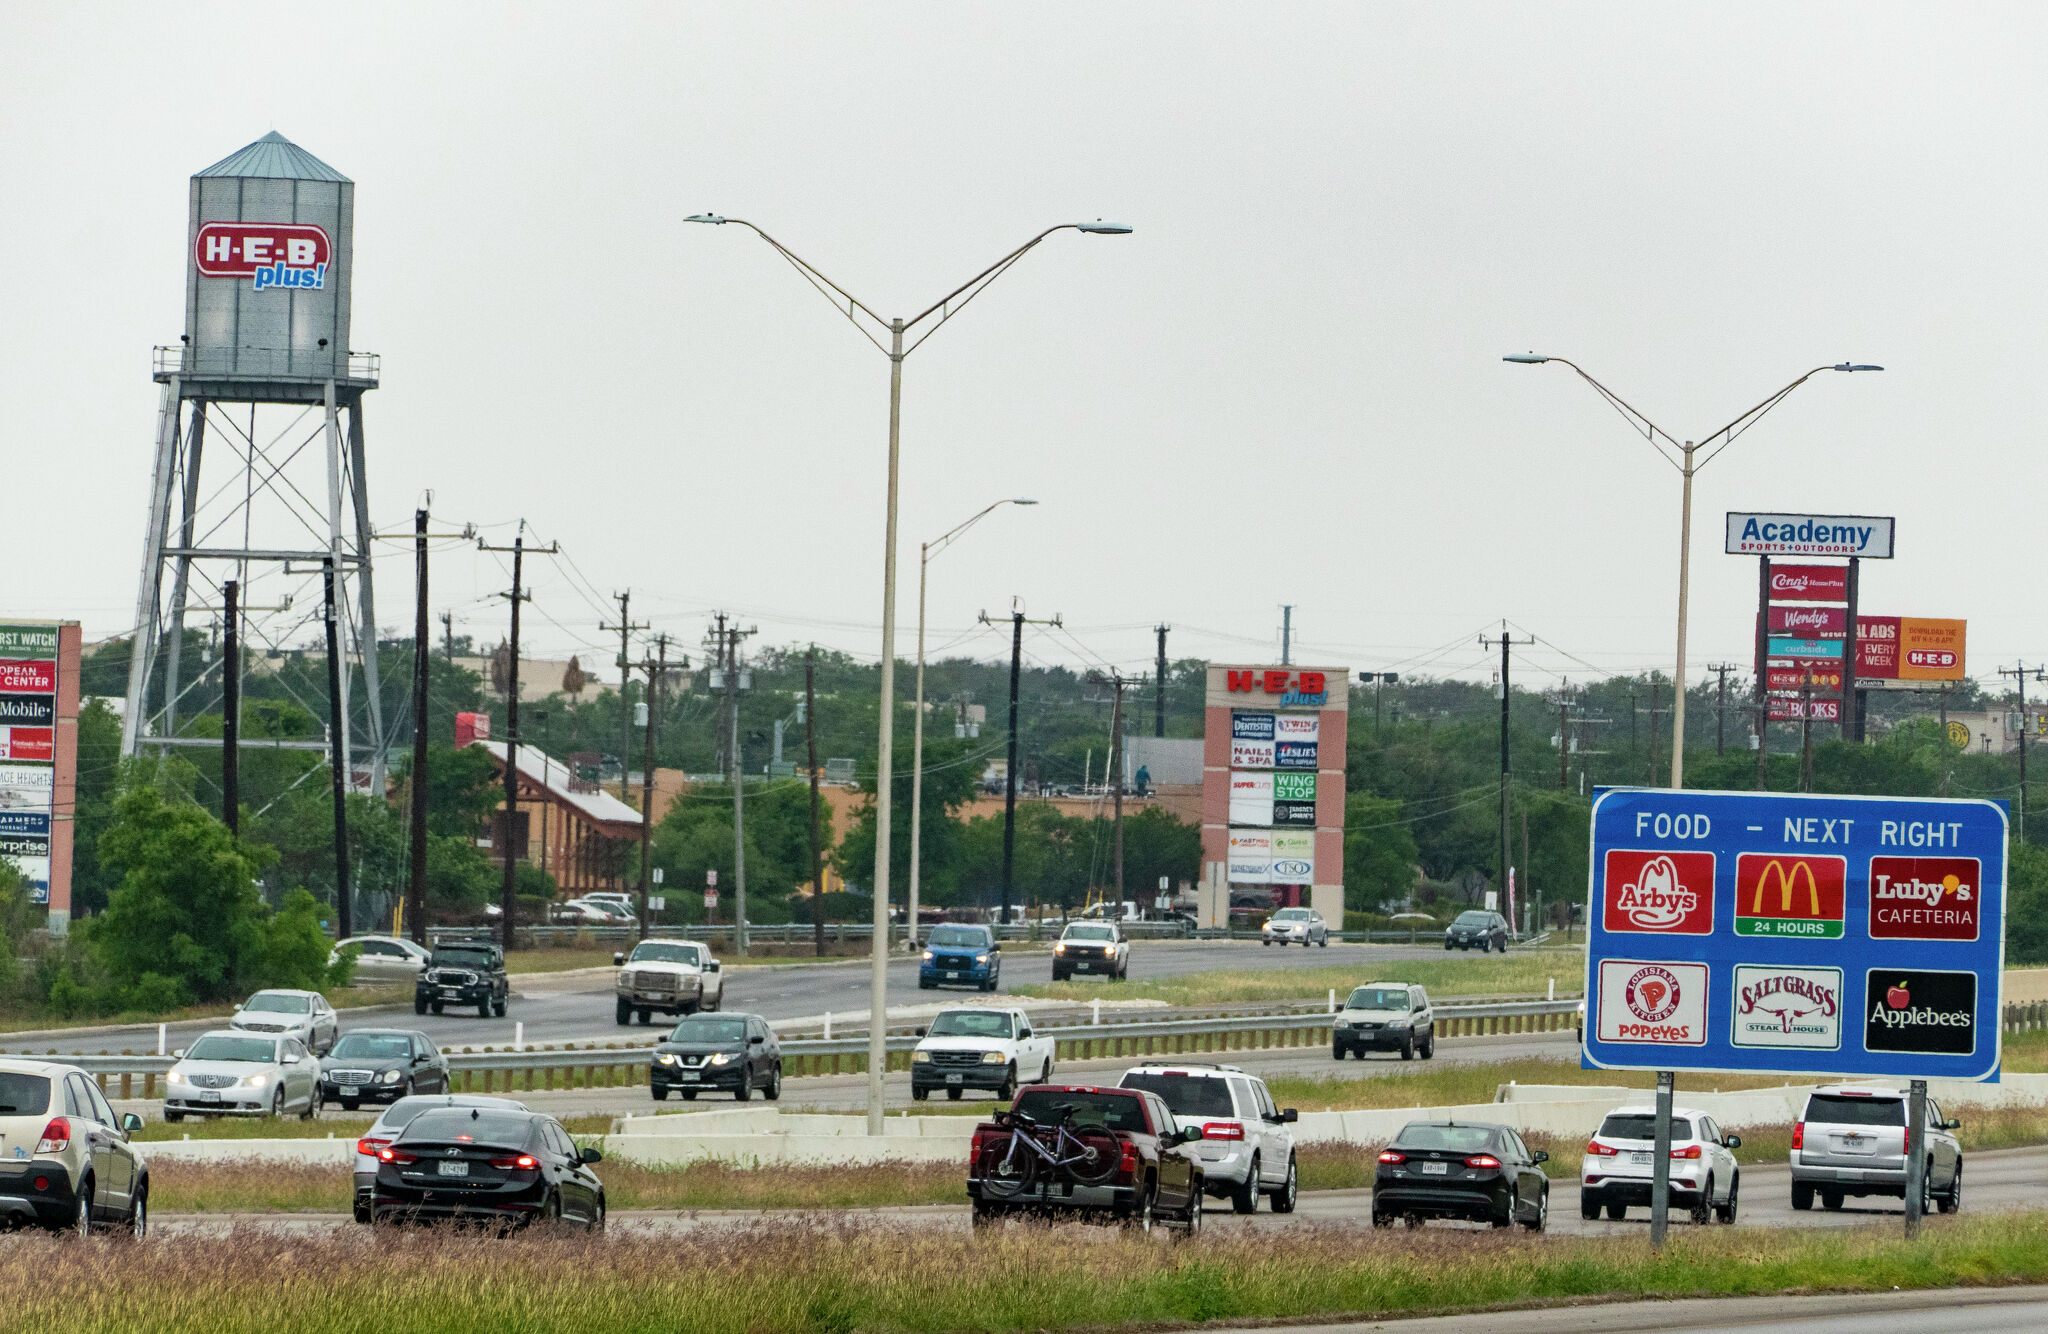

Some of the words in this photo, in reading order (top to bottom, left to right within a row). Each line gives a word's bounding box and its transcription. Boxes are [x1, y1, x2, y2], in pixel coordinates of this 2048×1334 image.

[255, 262, 325, 289] plus!
[1741, 518, 1872, 550] Academy
[1772, 574, 1808, 591] Conn's
[1785, 609, 1829, 628] Wendy's
[1870, 624, 1896, 638] ADS
[21, 633, 56, 646] WATCH
[1785, 646, 1827, 654] curbside
[1865, 644, 1896, 655] EVERY
[1865, 655, 1893, 666] WEEK
[4, 676, 49, 687] CENTER
[1280, 688, 1328, 707] plus!
[1234, 720, 1273, 731] DENTISTRY
[1284, 720, 1311, 728] TWIN
[1233, 747, 1273, 756] NAILS
[1233, 756, 1243, 764] &
[1247, 756, 1273, 766] SPA
[17, 772, 53, 787] HEIGHTS
[1276, 775, 1315, 787] WING
[1276, 786, 1315, 798] STOP
[1636, 812, 1711, 839] FOOD
[1784, 817, 1855, 844] NEXT
[1880, 820, 1963, 848] RIGHT
[1875, 874, 1971, 906] Luby's
[1620, 886, 1696, 914] Arby's
[1877, 908, 1973, 924] CAFETERIA
[1754, 922, 1770, 932] 24
[1777, 922, 1825, 934] HOURS
[1628, 967, 1679, 992] LOUISIANA
[1738, 975, 1836, 1017] SALTGRASS
[1629, 1002, 1677, 1021] KITCHEN
[1869, 1001, 1971, 1029] Applebee's
